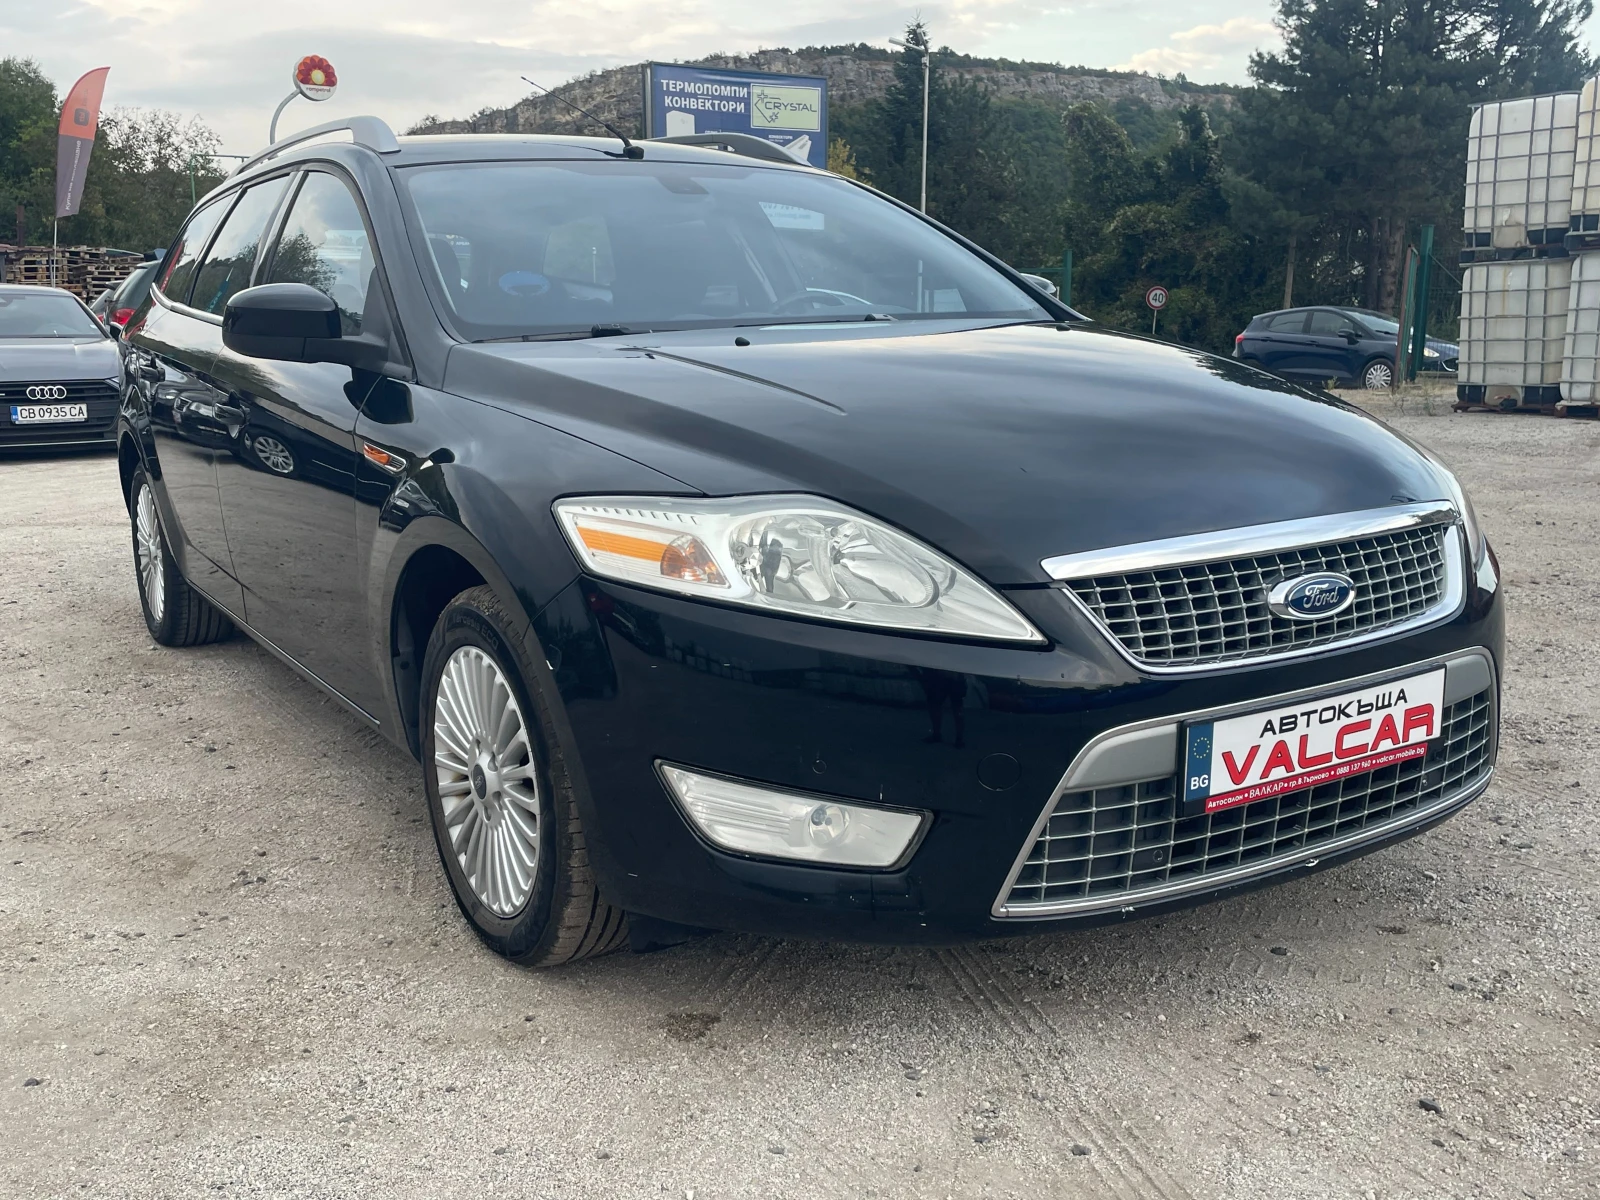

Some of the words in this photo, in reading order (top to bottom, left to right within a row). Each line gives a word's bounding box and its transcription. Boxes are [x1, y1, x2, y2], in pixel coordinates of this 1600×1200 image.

[660, 79, 748, 98] ТЕРМОПОМПИ
[664, 95, 745, 113] КОНВЕКТОРИ
[764, 101, 818, 113] CRYSTAL
[1151, 292, 1164, 304] 40
[20, 408, 36, 419] CB
[38, 407, 67, 419] 0935
[69, 406, 85, 417] CA
[1303, 583, 1340, 608] Ford
[1222, 703, 1435, 785] VALCAR
[1190, 773, 1209, 790] BG
[1207, 794, 1243, 808] Автосалон
[1249, 782, 1284, 798] ВАЛКАР
[1336, 766, 1350, 775] 0888
[1351, 763, 1361, 773] 137
[1376, 747, 1425, 764] valcar.mobile.bg
